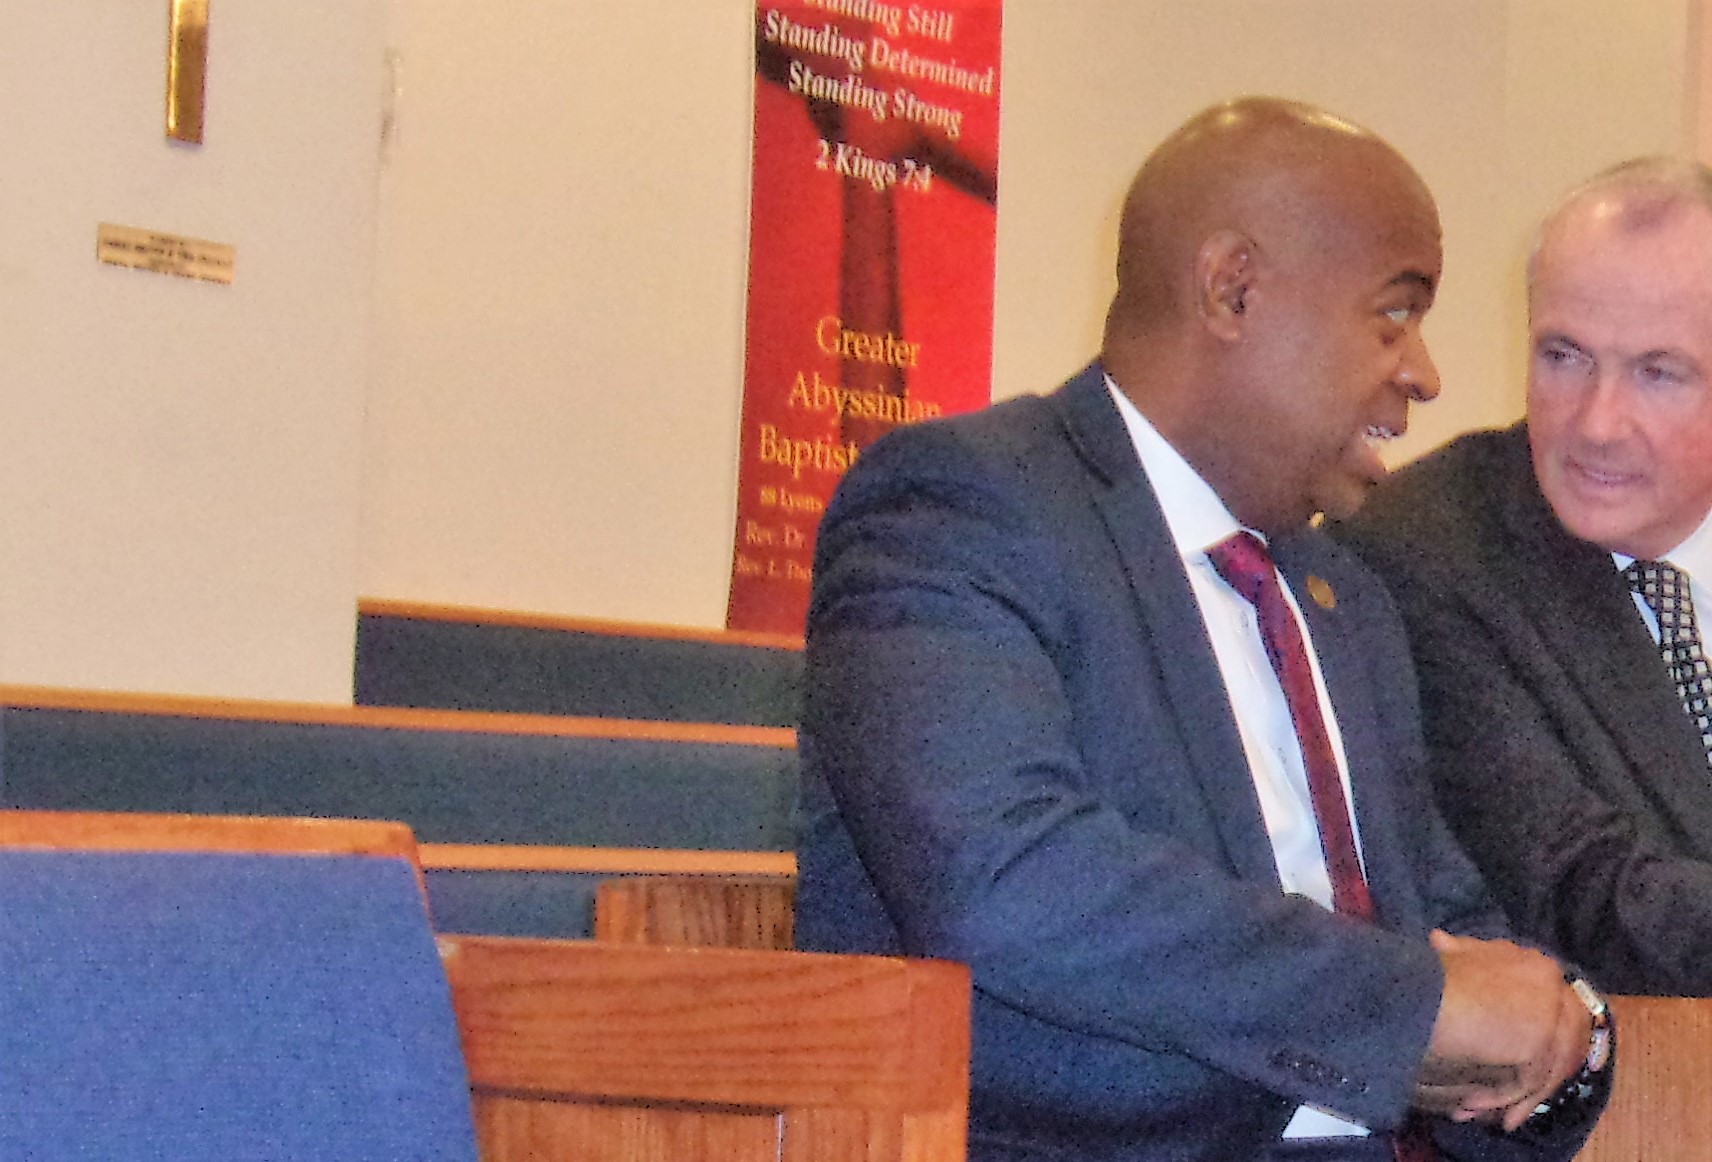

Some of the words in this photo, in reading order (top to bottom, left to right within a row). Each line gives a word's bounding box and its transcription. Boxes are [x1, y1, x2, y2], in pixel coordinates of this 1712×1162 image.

[906, 4, 955, 43] Still
[764, 8, 866, 72] Standing
[870, 37, 995, 97] Determined
[788, 60, 888, 123] Standing
[892, 88, 963, 138] Strong
[815, 138, 831, 171] 2
[833, 142, 898, 192] Kings
[902, 158, 933, 193] 7:4
[815, 316, 921, 368] Greater
[788, 370, 942, 426] Abyssinian
[760, 424, 860, 480] Baptist
